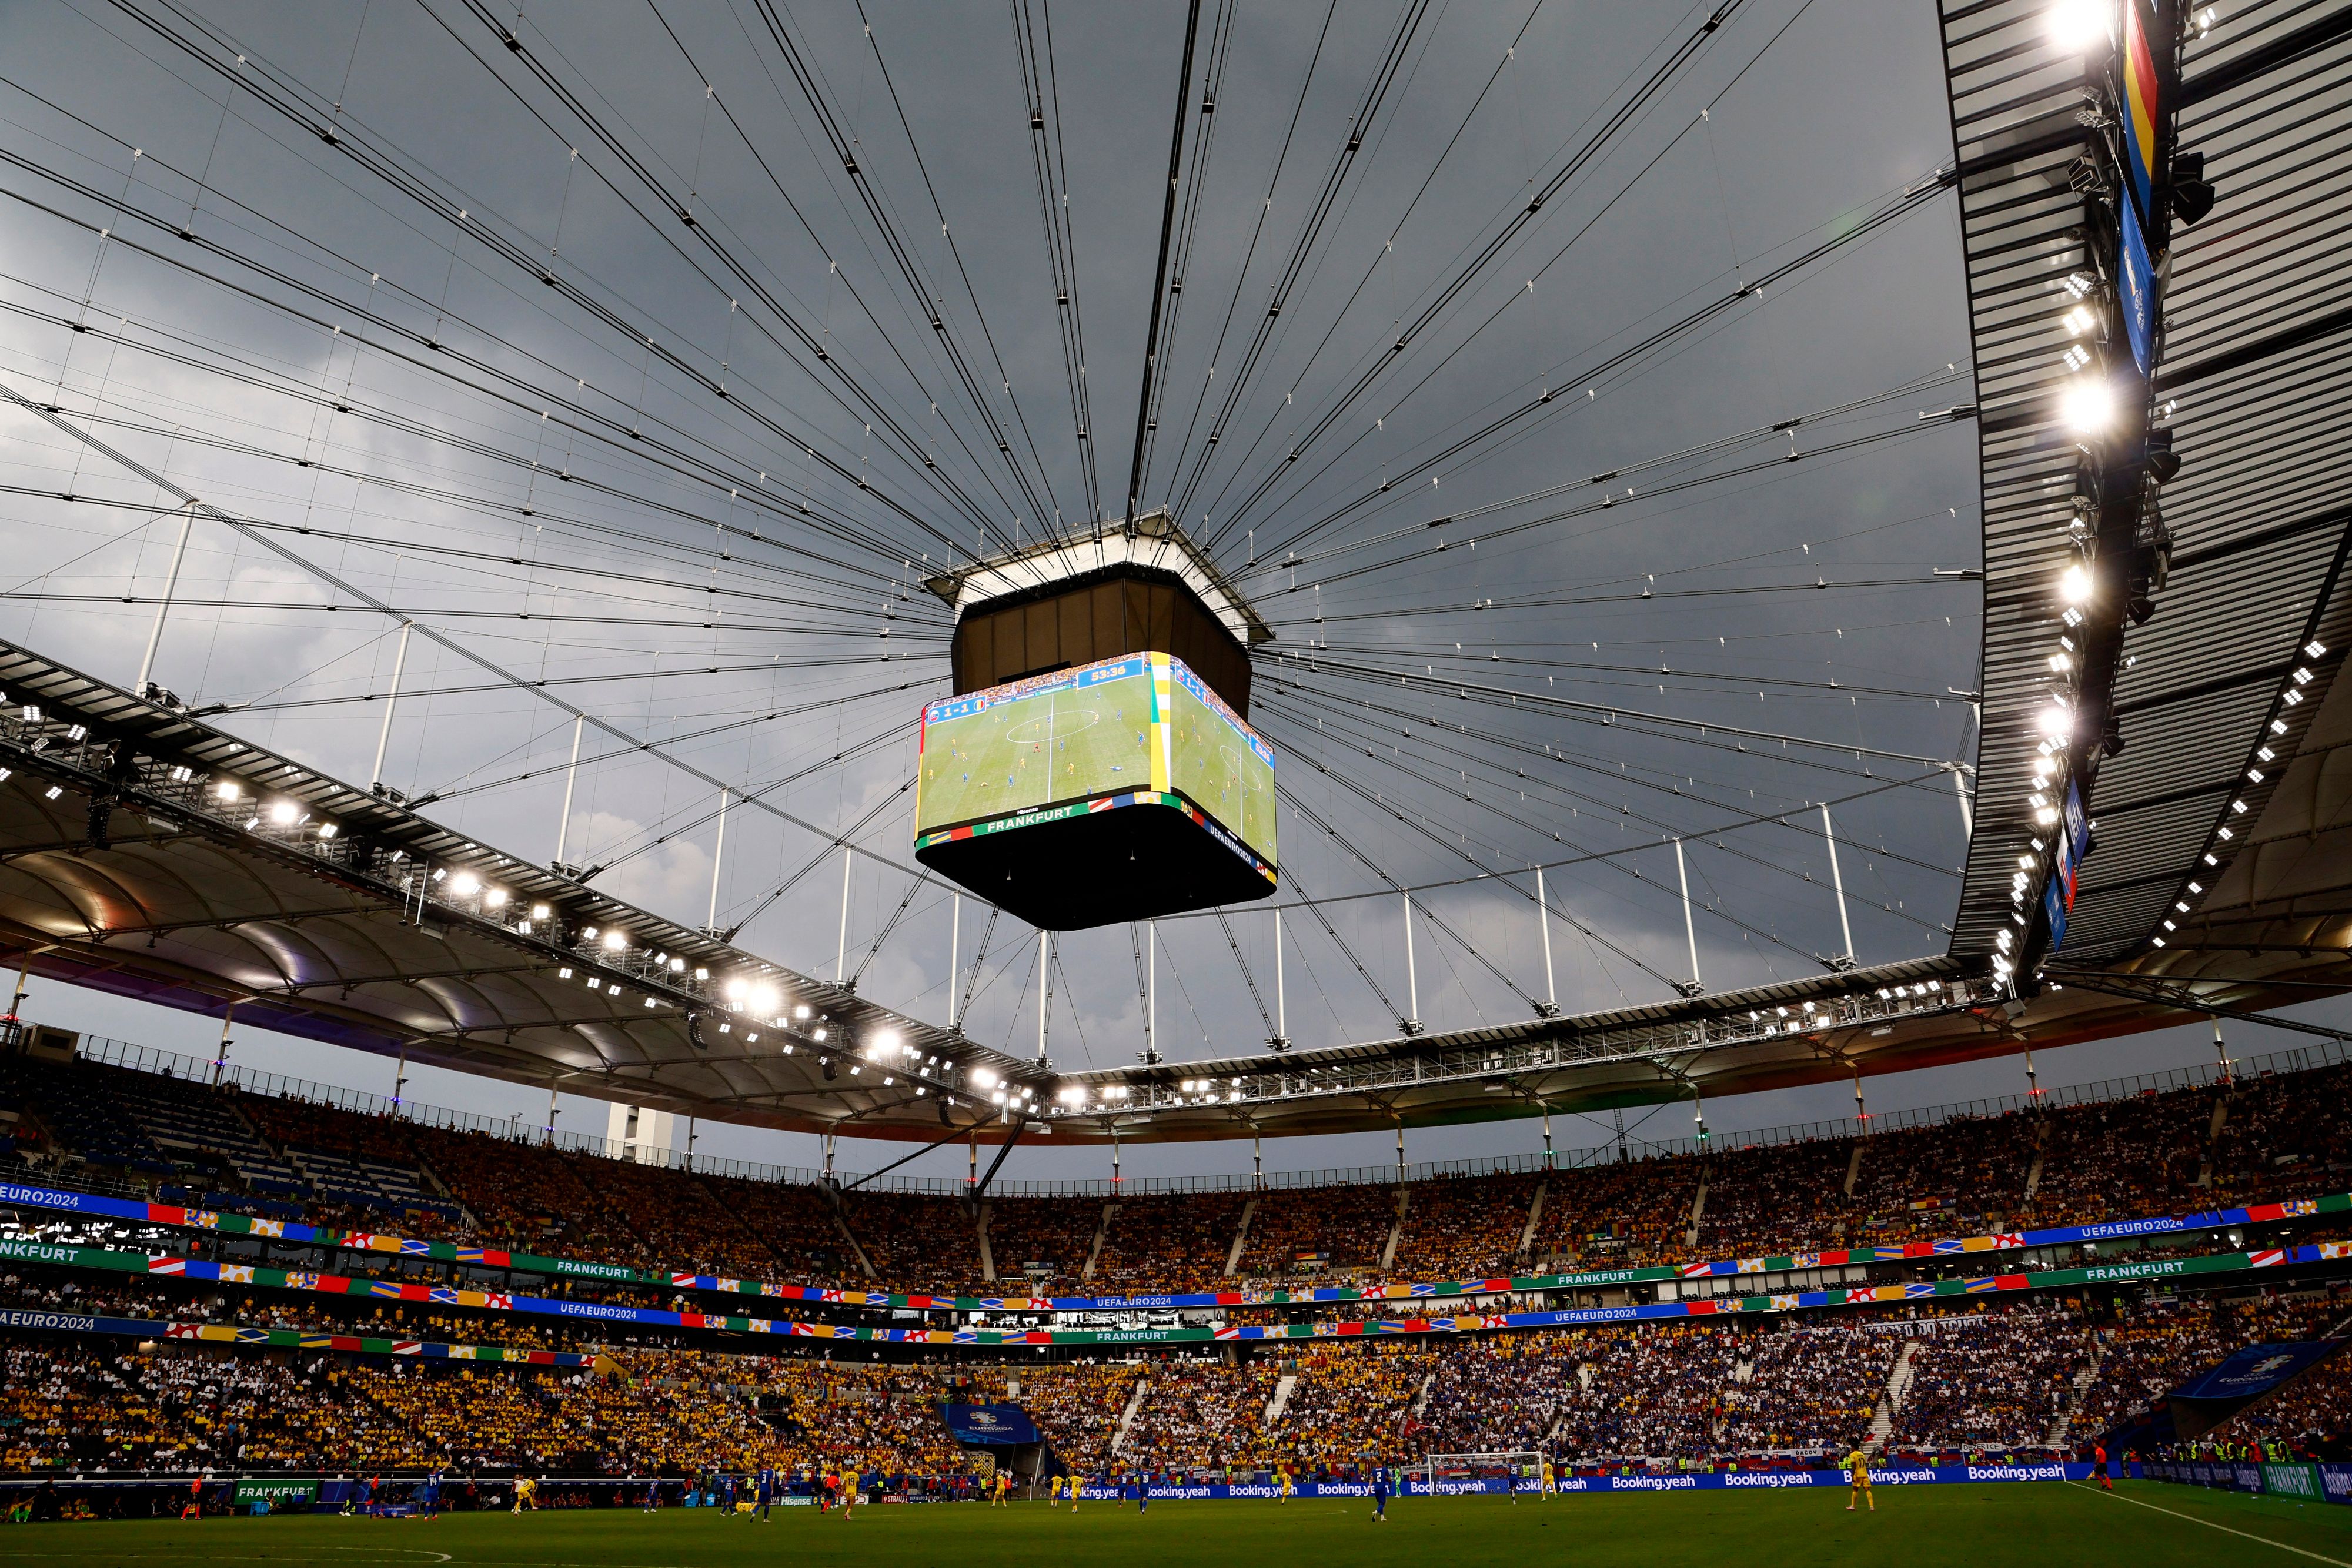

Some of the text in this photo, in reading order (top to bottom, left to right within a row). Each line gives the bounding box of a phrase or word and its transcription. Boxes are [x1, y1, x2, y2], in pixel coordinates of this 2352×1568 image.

[1091, 666, 1126, 681] 53:36
[1017, 807, 1039, 815] Hisense
[988, 807, 1073, 833] FRANKFURT
[557, 1262, 629, 1278] FRANKFURT
[2086, 1262, 2184, 1280] FRANKFURT
[1558, 1271, 1634, 1285] FRANKFURT
[1097, 1332, 1168, 1341] FRANKFURT
[762, 1473, 767, 1483] 3
[1142, 1474, 1149, 1483] 19
[1377, 1472, 1382, 1482] 2
[1725, 1472, 1813, 1487] Booking.yeah
[1843, 1468, 1936, 1485] Bking.yeah
[1967, 1465, 2065, 1482] Booking.yeah
[429, 1477, 437, 1486] 14
[848, 1477, 854, 1486] 19
[1612, 1473, 1696, 1490] Booking.yeah
[2265, 1466, 2315, 1496] FRANKFURT
[1230, 1484, 1298, 1498] Booking.yeh
[781, 1496, 811, 1506] Hisense
